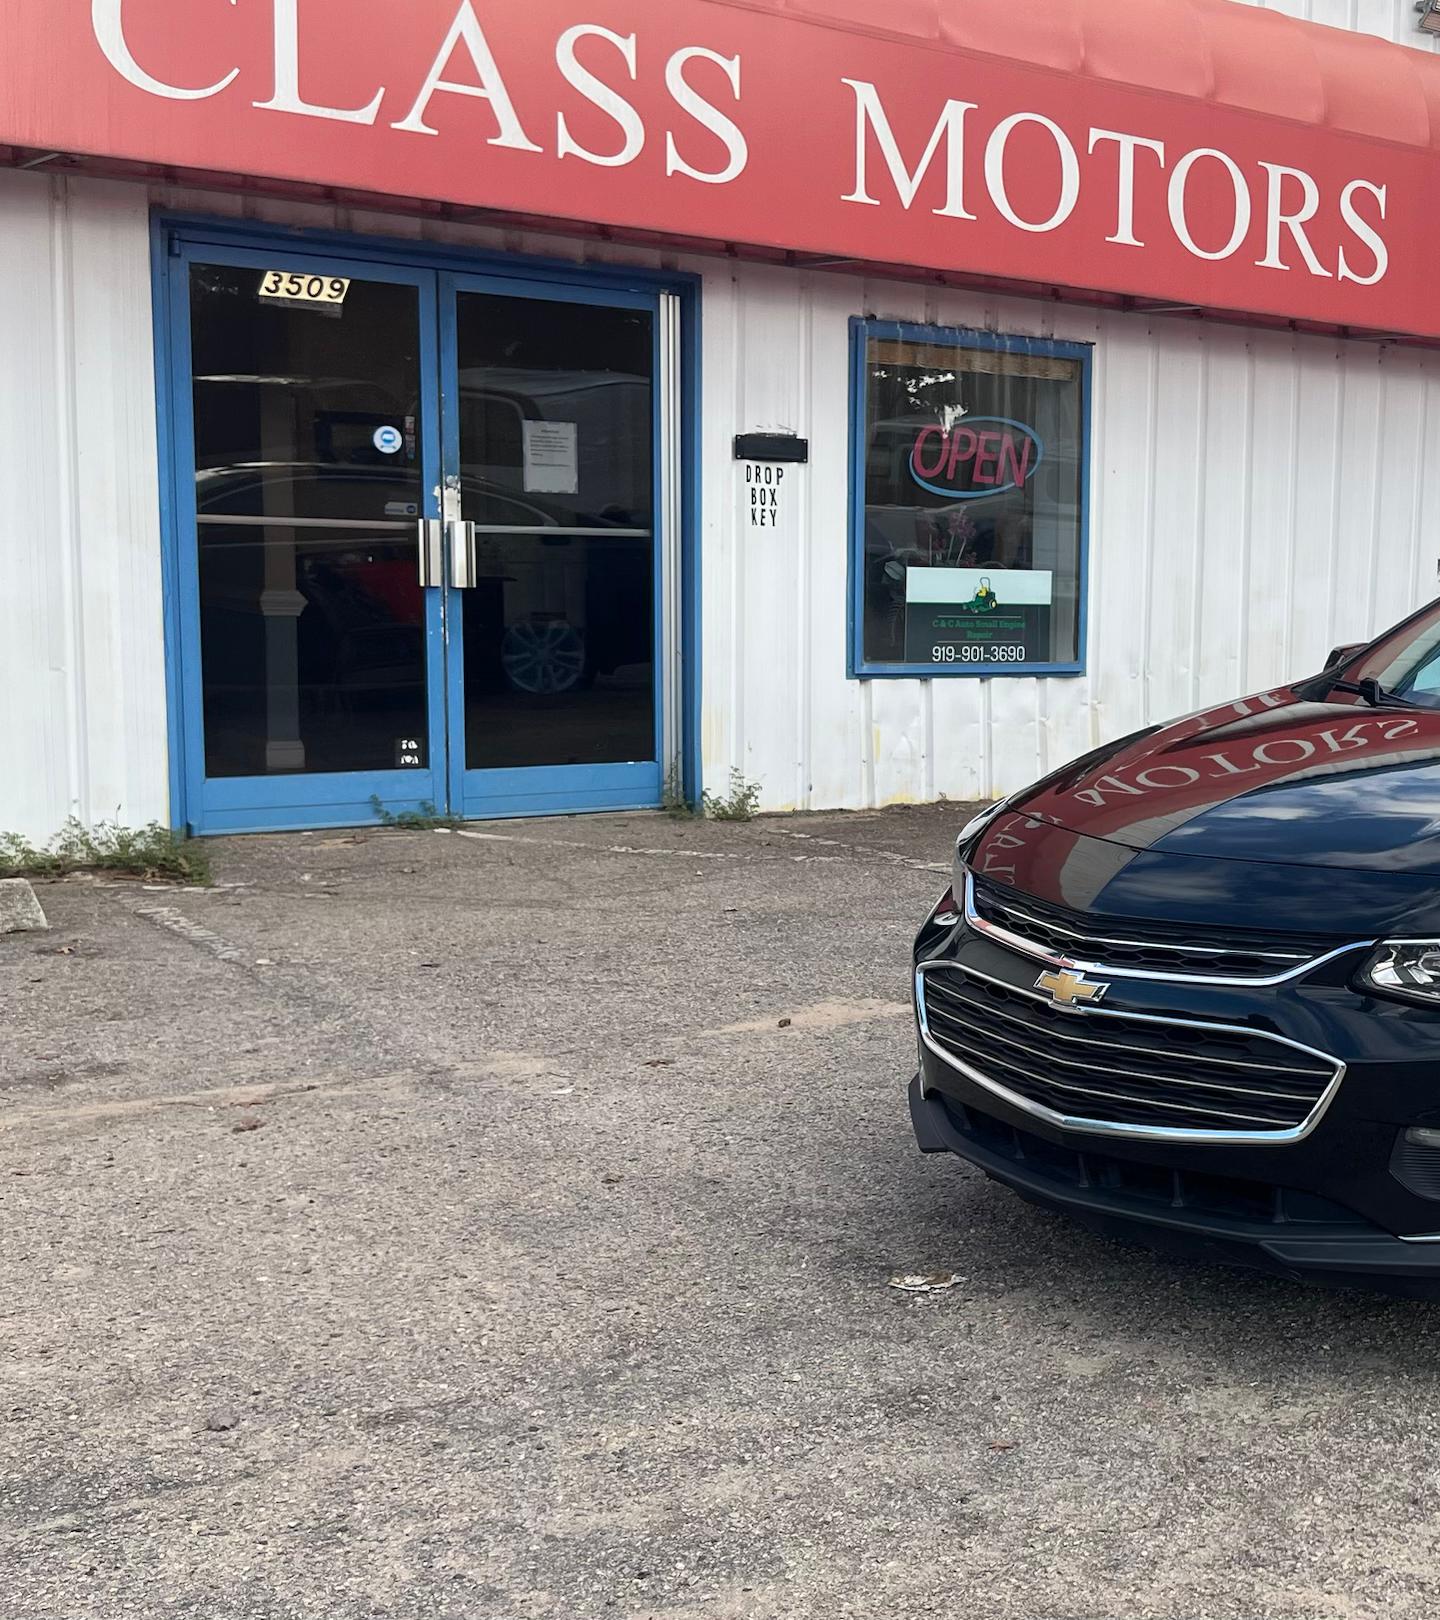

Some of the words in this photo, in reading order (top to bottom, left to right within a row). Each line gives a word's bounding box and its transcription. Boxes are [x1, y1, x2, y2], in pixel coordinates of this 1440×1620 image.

[90, 0, 749, 185] CLASS
[840, 76, 1390, 286] MOTORS
[264, 272, 345, 299] 3509
[912, 423, 1032, 488] OPEN
[746, 464, 784, 485] DROP
[751, 487, 777, 506] BOX
[751, 507, 777, 526] KEY
[932, 646, 1025, 662] 919-901-3690
